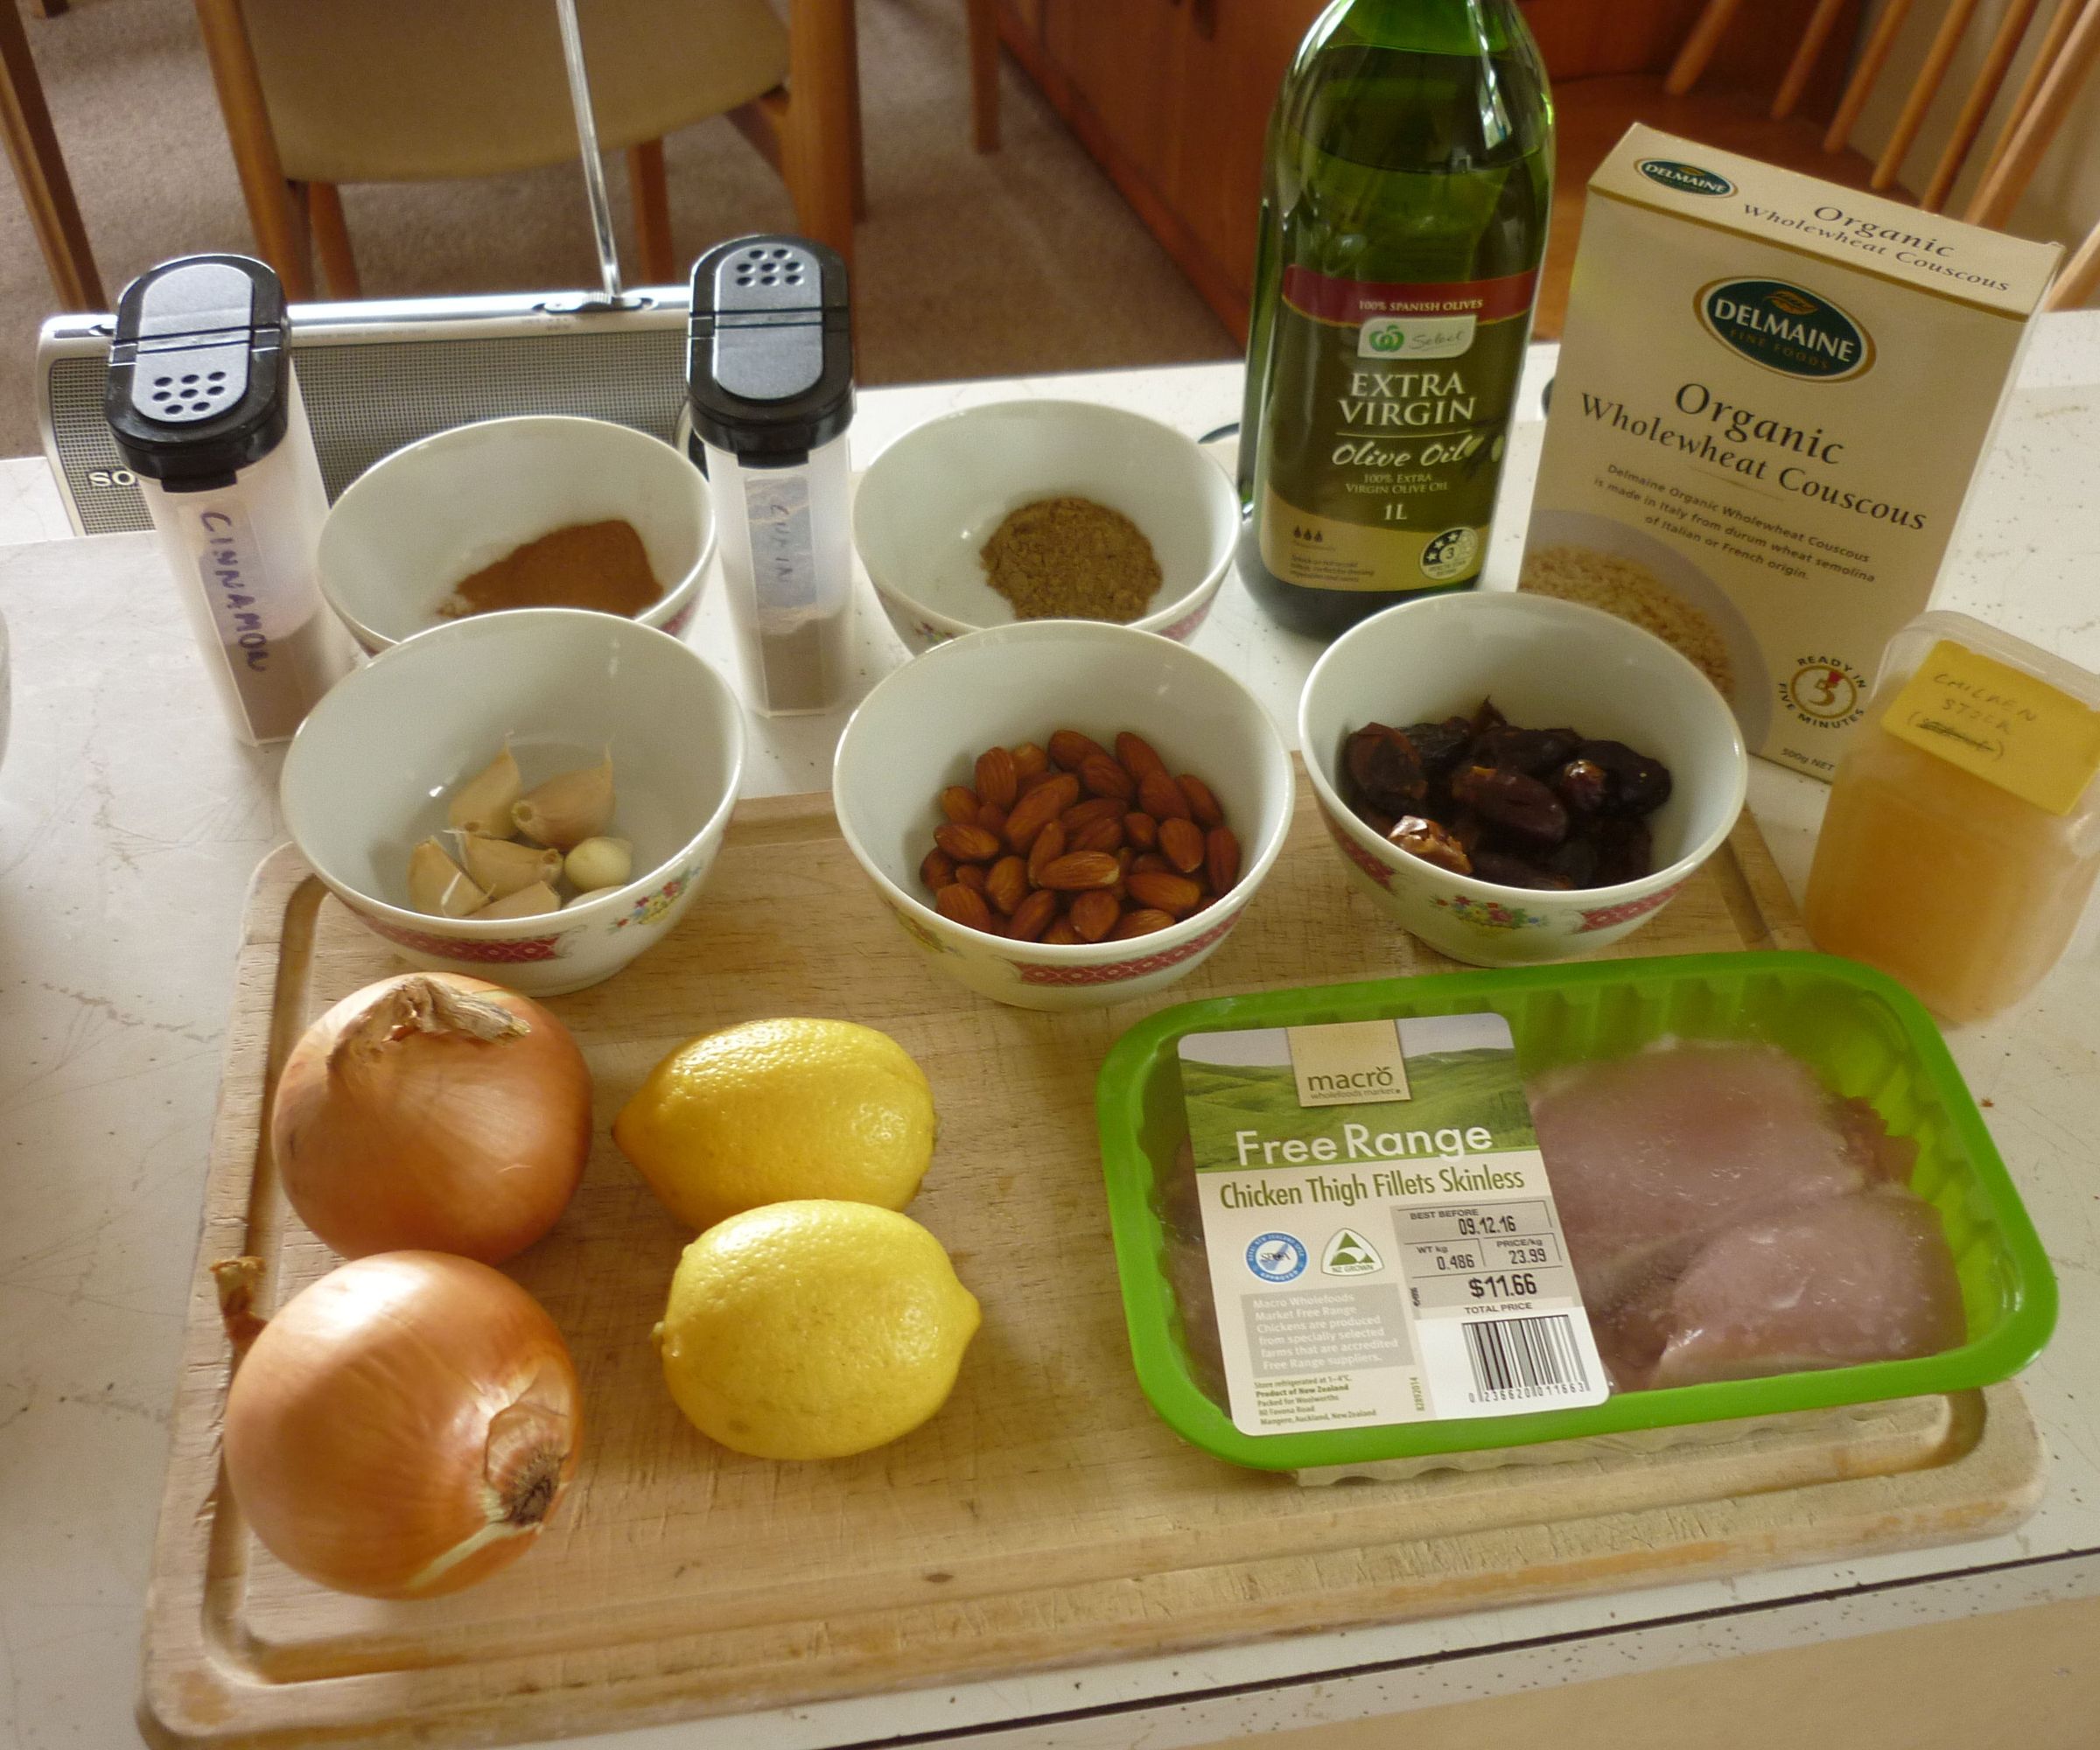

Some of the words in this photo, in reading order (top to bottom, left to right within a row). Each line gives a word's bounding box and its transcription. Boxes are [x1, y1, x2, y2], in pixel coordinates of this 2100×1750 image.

[1645, 164, 1727, 192] DELMAINE
[1814, 206, 1956, 258] Organic
[1744, 204, 1887, 256] Wholewheat
[1896, 251, 2010, 293] Couscous
[1359, 300, 1387, 311] 100%
[1389, 301, 1440, 312] SPANISH
[1443, 299, 1484, 311] OLIVES
[1714, 298, 1856, 362] DELMAINE
[1351, 372, 1466, 398] EXTRA
[1338, 397, 1477, 426] VIRGIN
[1676, 382, 1844, 465] Organic
[1332, 441, 1411, 467] Olive
[1420, 435, 1474, 466] Oil
[1581, 392, 1769, 480] Wholewheat
[1779, 466, 1928, 532] Couscous
[88, 471, 136, 486] SO
[1346, 483, 1389, 494] VIRGIN
[1392, 484, 1427, 494] OLIVE
[1429, 482, 1448, 492] OIL
[1364, 473, 1394, 484] 100%
[1384, 503, 1407, 521] 1L
[1608, 464, 1665, 492] Delmaine
[1670, 487, 1719, 511] Organic
[1722, 506, 1805, 542] Wholewheat
[1808, 536, 1870, 563] Couscous
[1594, 478, 1604, 487] is
[1607, 483, 1642, 501] made
[1644, 495, 1656, 507] in
[1660, 501, 1688, 520] Italy
[1690, 513, 1722, 531] from
[1725, 526, 1768, 548] durum
[1771, 542, 1813, 563] wheat
[1816, 558, 1876, 583] semolina
[1645, 515, 1660, 525] of
[1662, 521, 1702, 542] Italian
[1704, 537, 1719, 548] or
[1722, 542, 1765, 565] French
[1446, 547, 1454, 560] 3
[200, 511, 270, 672] CINNAMON
[1797, 655, 1853, 674] READY
[1853, 674, 1866, 689] IN
[1778, 682, 1796, 710] FIVE
[1798, 708, 1865, 729] MINUTES
[1810, 758, 1835, 771] NET
[1236, 1130, 1338, 1166] Free
[1344, 1124, 1494, 1162] Range
[1220, 1181, 1302, 1209] Chicken
[1306, 1172, 1368, 1207] Thigh
[1373, 1169, 1436, 1198] Fillets
[1443, 1165, 1524, 1193] Skinless
[1438, 1209, 1479, 1218] BEFORE
[1459, 1215, 1516, 1236] 09.12.16
[1496, 1239, 1544, 1248] PRICE/kg
[1436, 1254, 1475, 1270] 0.486
[1508, 1248, 1547, 1264] 23.99
[1469, 1273, 1537, 1298] $11.66
[1253, 1299, 1287, 1309] Macro
[1290, 1293, 1354, 1307] Wholefoods
[1465, 1306, 1498, 1314] TOTAL
[1501, 1302, 1533, 1312] PRICE
[1256, 1310, 1293, 1321] Market
[1296, 1308, 1320, 1318] Free
[1323, 1306, 1357, 1318] Range
[1256, 1322, 1307, 1334] Chickens
[1330, 1315, 1381, 1329] produced
[1258, 1336, 1284, 1345] from
[1287, 1331, 1336, 1344] specially
[1338, 1327, 1385, 1340] selected
[1261, 1348, 1292, 1358] farms
[1296, 1345, 1318, 1354] that
[1340, 1338, 1398, 1351] accredited
[1263, 1361, 1287, 1370] Free
[1290, 1358, 1325, 1369] Range
[1256, 1389, 1287, 1398] Product
[1317, 1383, 1348, 1393] Zealand
[1484, 1387, 1531, 1402] 236620
[1538, 1382, 1585, 1396] 011663
[1257, 1398, 1283, 1407] Packed
